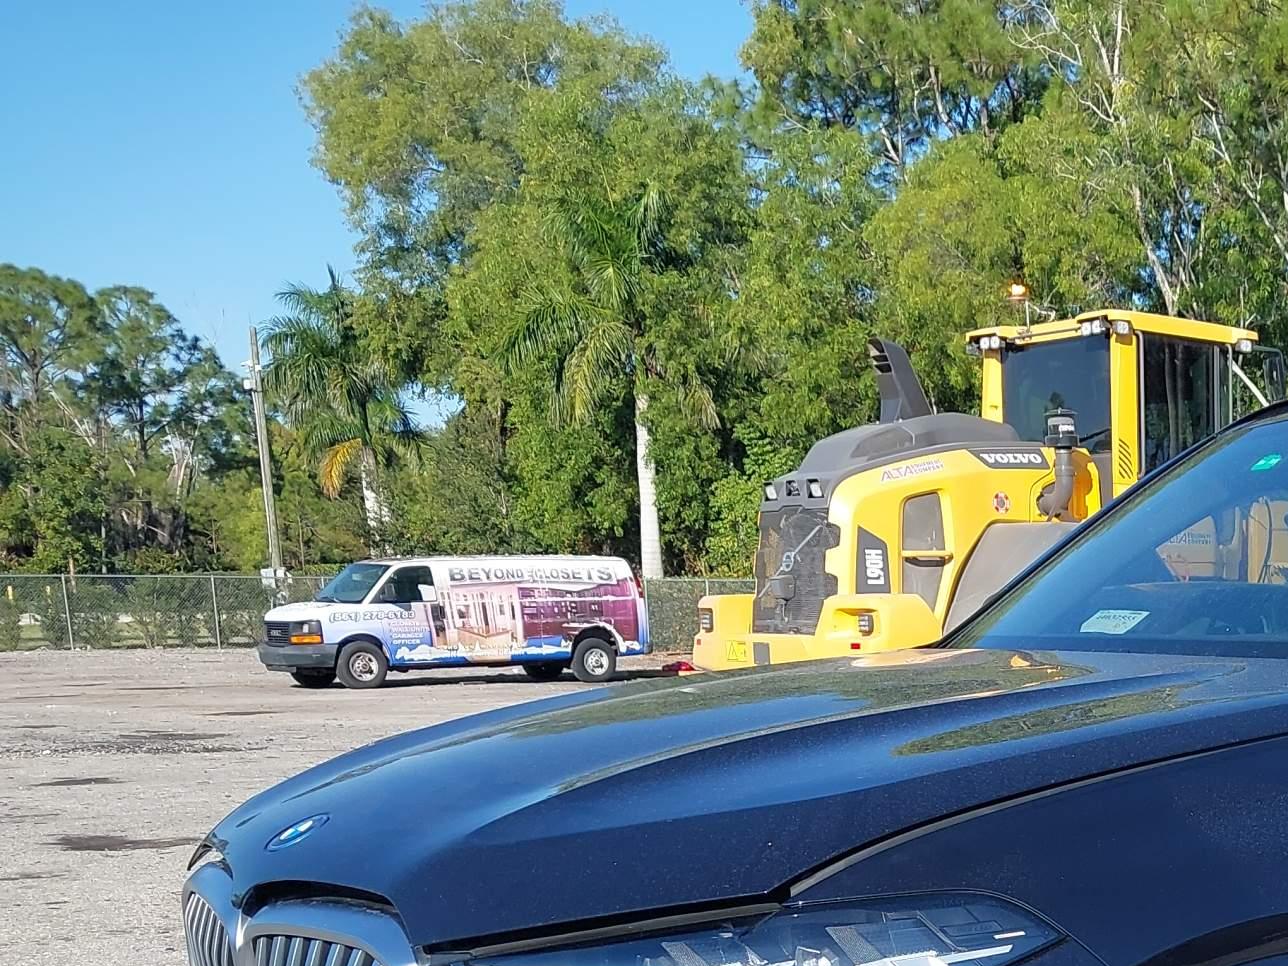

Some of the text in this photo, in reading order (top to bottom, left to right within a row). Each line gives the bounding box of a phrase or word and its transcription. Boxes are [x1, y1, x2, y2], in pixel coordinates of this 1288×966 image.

[979, 453, 1043, 464] VOLVO
[881, 465, 914, 481] ALTA
[864, 548, 885, 585] L90H
[449, 567, 524, 581] BEYOND
[534, 567, 613, 580] CLOSETS
[329, 612, 361, 623] (561)
